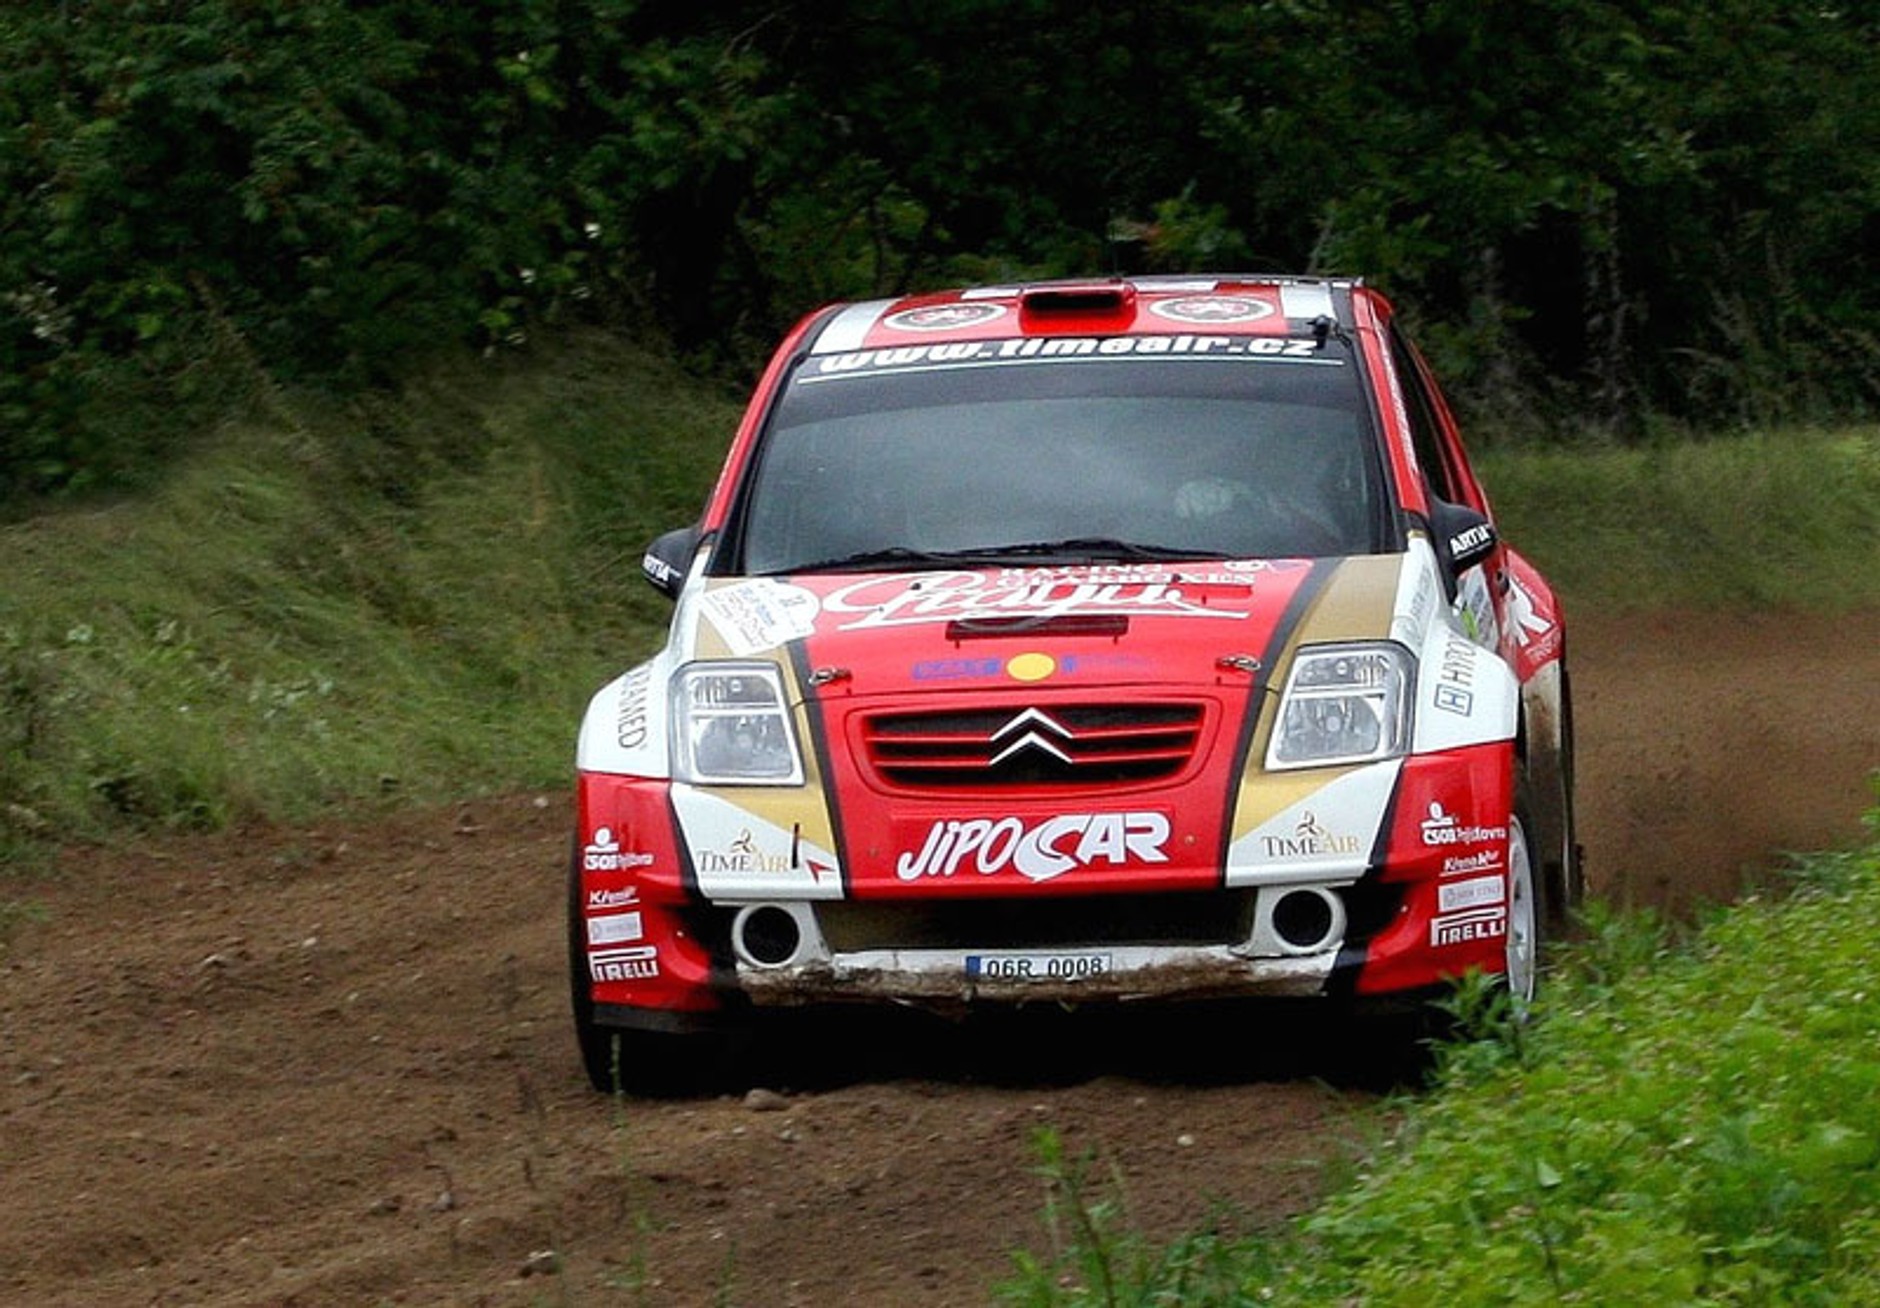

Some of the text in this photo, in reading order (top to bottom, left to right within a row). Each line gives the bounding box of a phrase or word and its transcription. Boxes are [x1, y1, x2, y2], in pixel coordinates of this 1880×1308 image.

[1431, 907, 1505, 947] PIRELLI
[588, 946, 659, 982] PIRELLI
[987, 958, 1103, 978] 06R 0008
